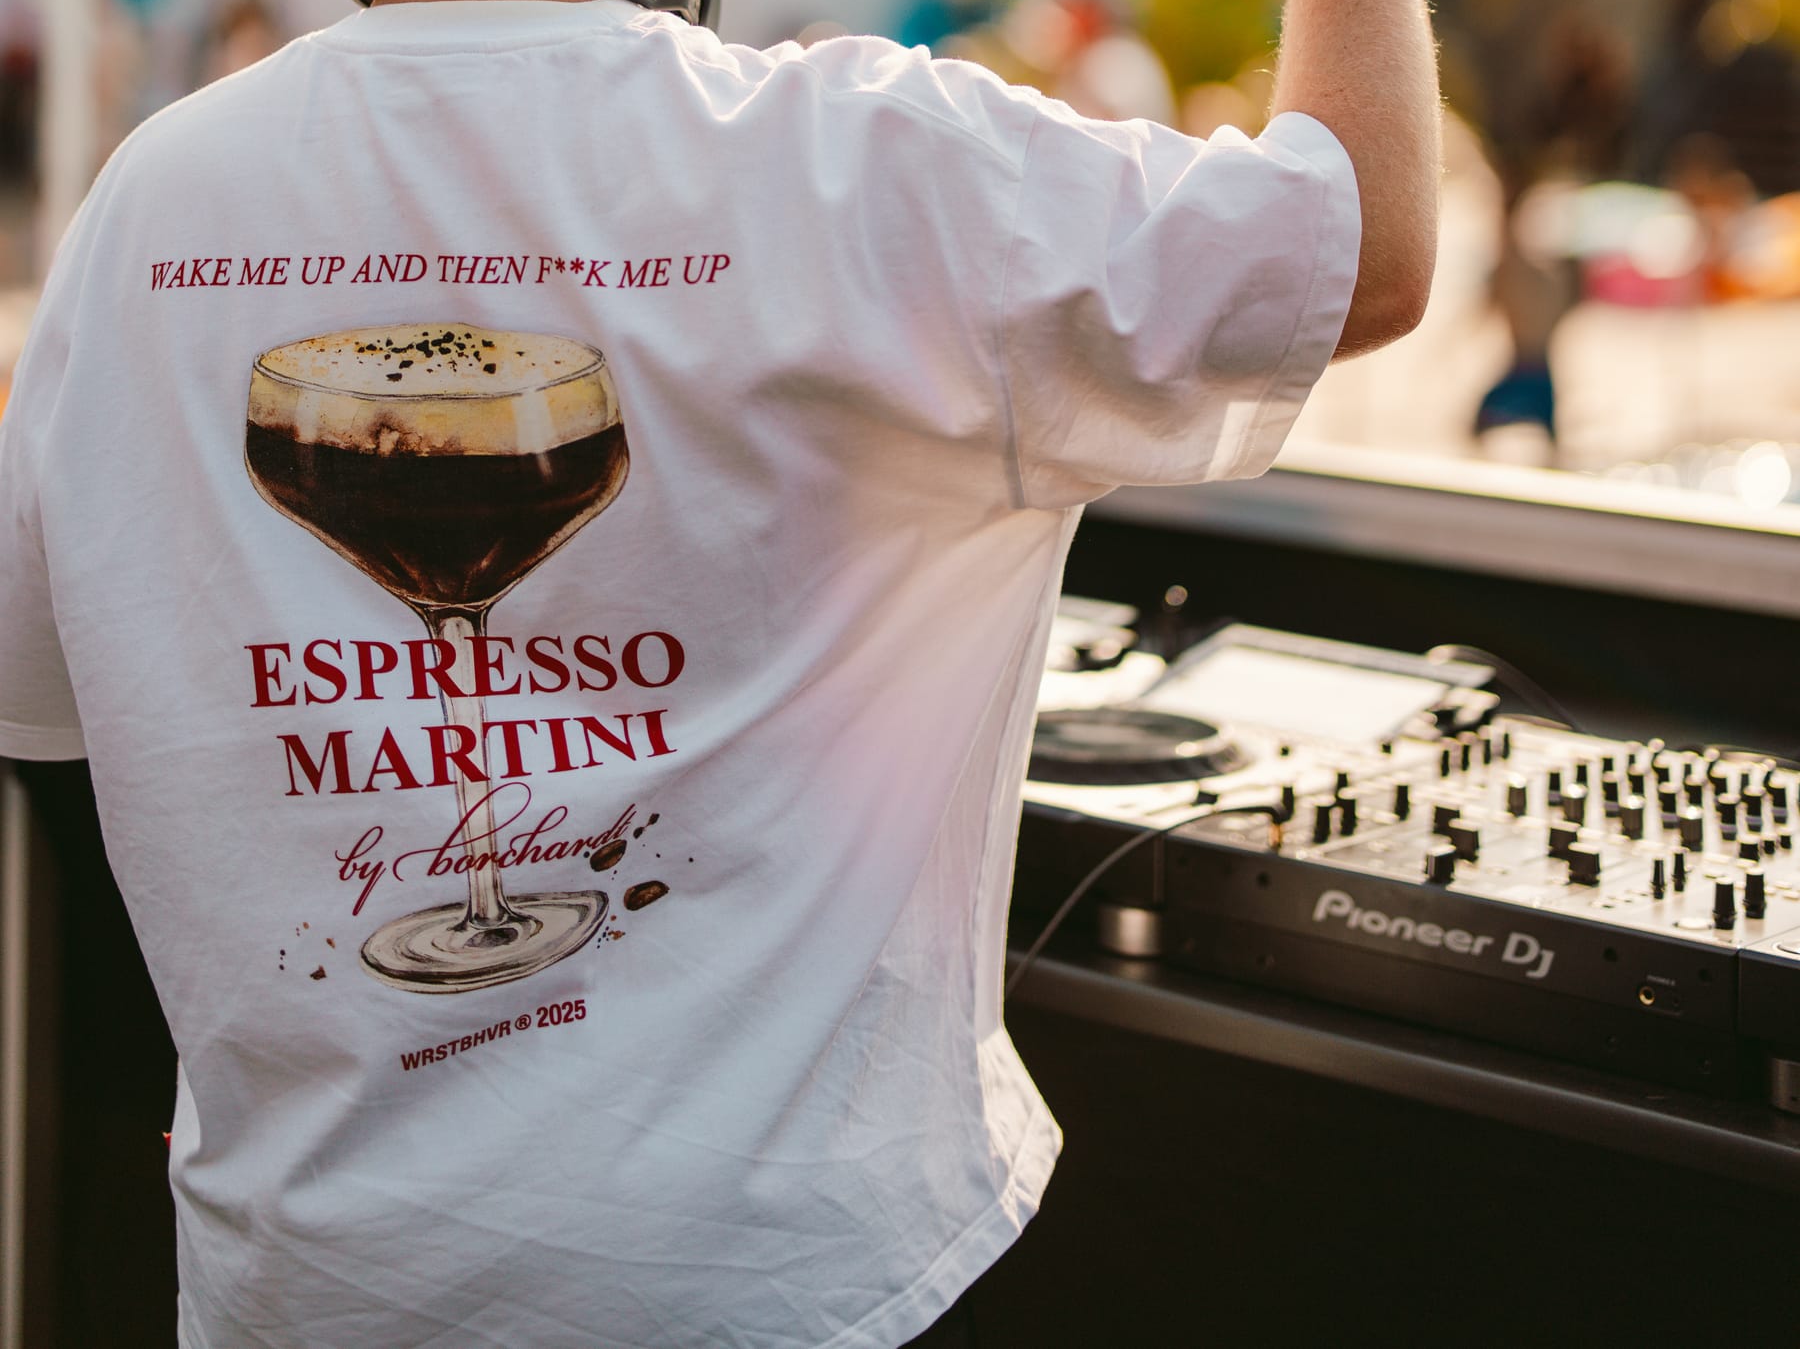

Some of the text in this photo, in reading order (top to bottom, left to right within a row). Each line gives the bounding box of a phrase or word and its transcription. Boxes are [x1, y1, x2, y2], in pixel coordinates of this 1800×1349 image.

[151, 257, 233, 290] WAKE
[238, 256, 291, 286] ME
[302, 255, 346, 285] UP
[352, 253, 428, 284] AND
[438, 255, 529, 285] THEN
[617, 257, 673, 289] ME
[684, 253, 731, 285] UP
[244, 631, 686, 708] ESPRESSO
[277, 709, 678, 797] MARTINI
[334, 781, 637, 917] by borchardt
[1312, 889, 1494, 957] Pioneer
[400, 1019, 512, 1071] WRSTBHVR
[536, 999, 587, 1029] 2025
